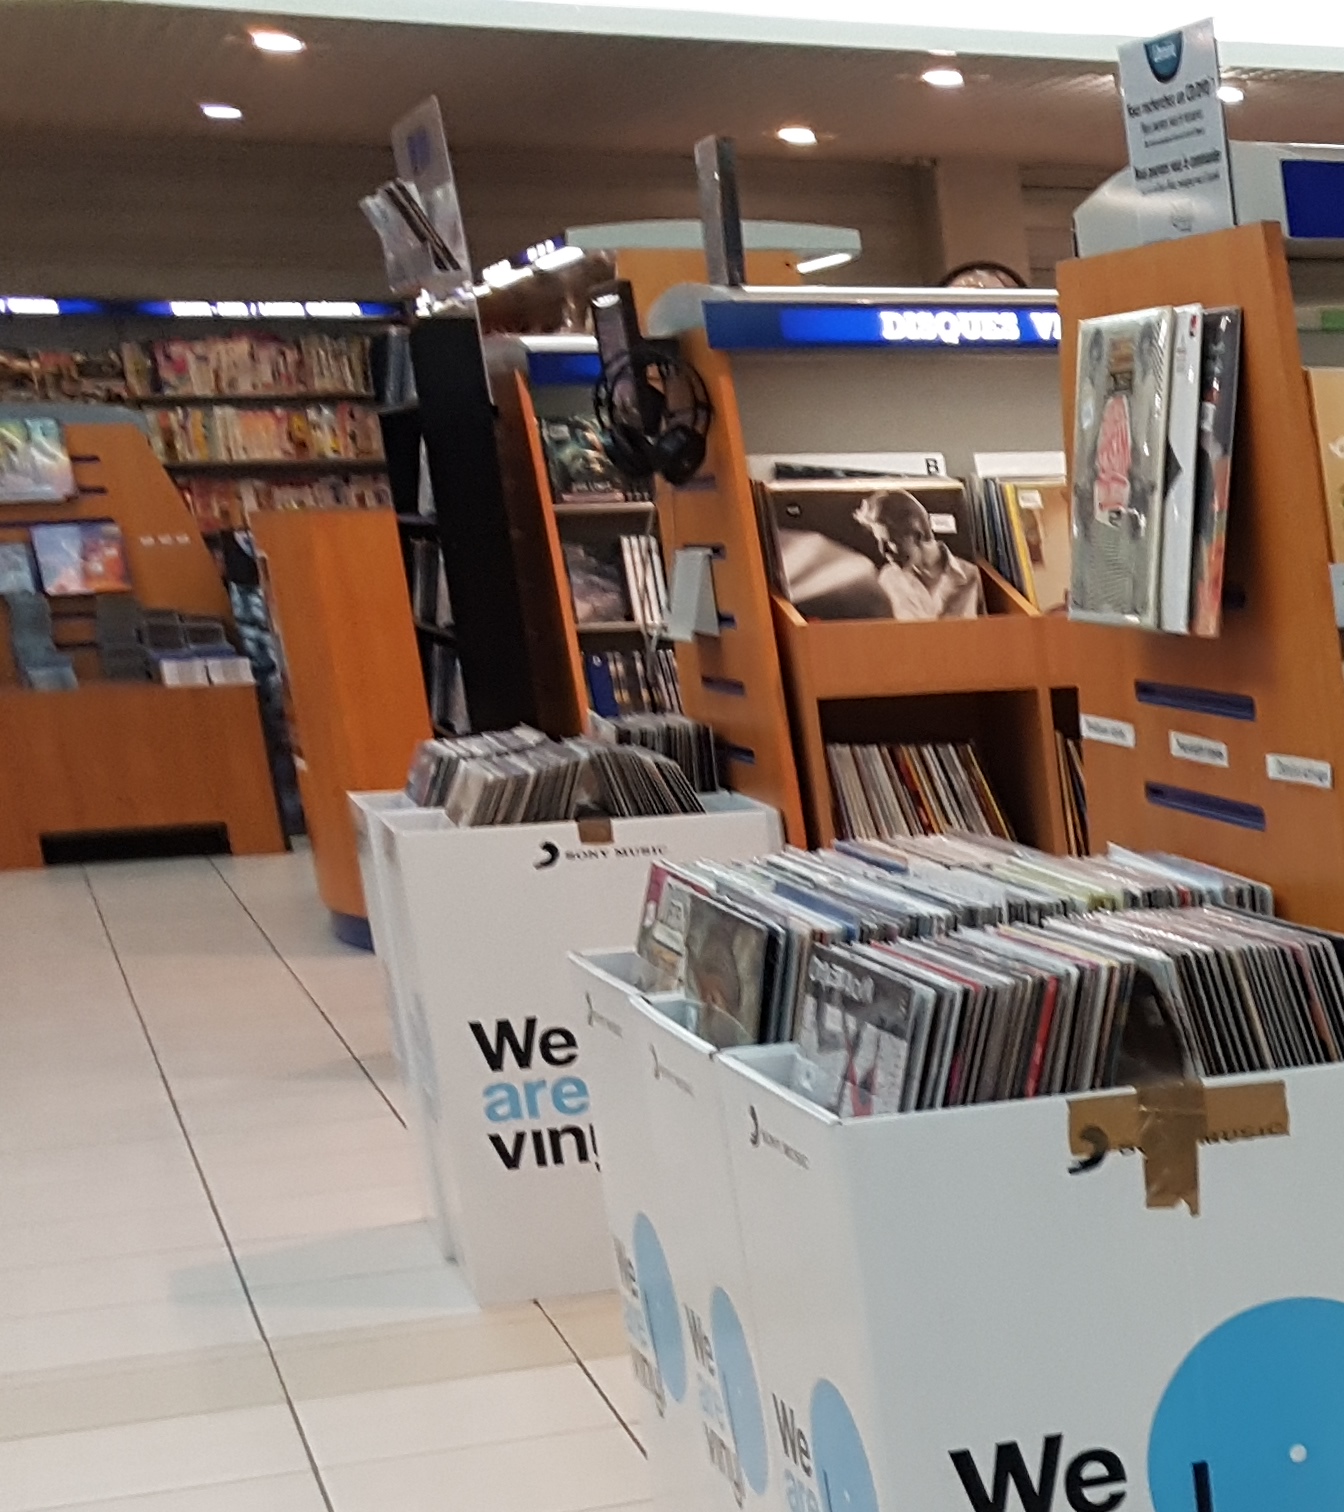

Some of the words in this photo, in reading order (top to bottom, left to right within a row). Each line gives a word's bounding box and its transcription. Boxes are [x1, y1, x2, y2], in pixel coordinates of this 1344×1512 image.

[880, 311, 1021, 344] DISQUES
[925, 458, 940, 476] B
[468, 1015, 579, 1073] We
[482, 1075, 590, 1124] are
[772, 1392, 812, 1478] We
